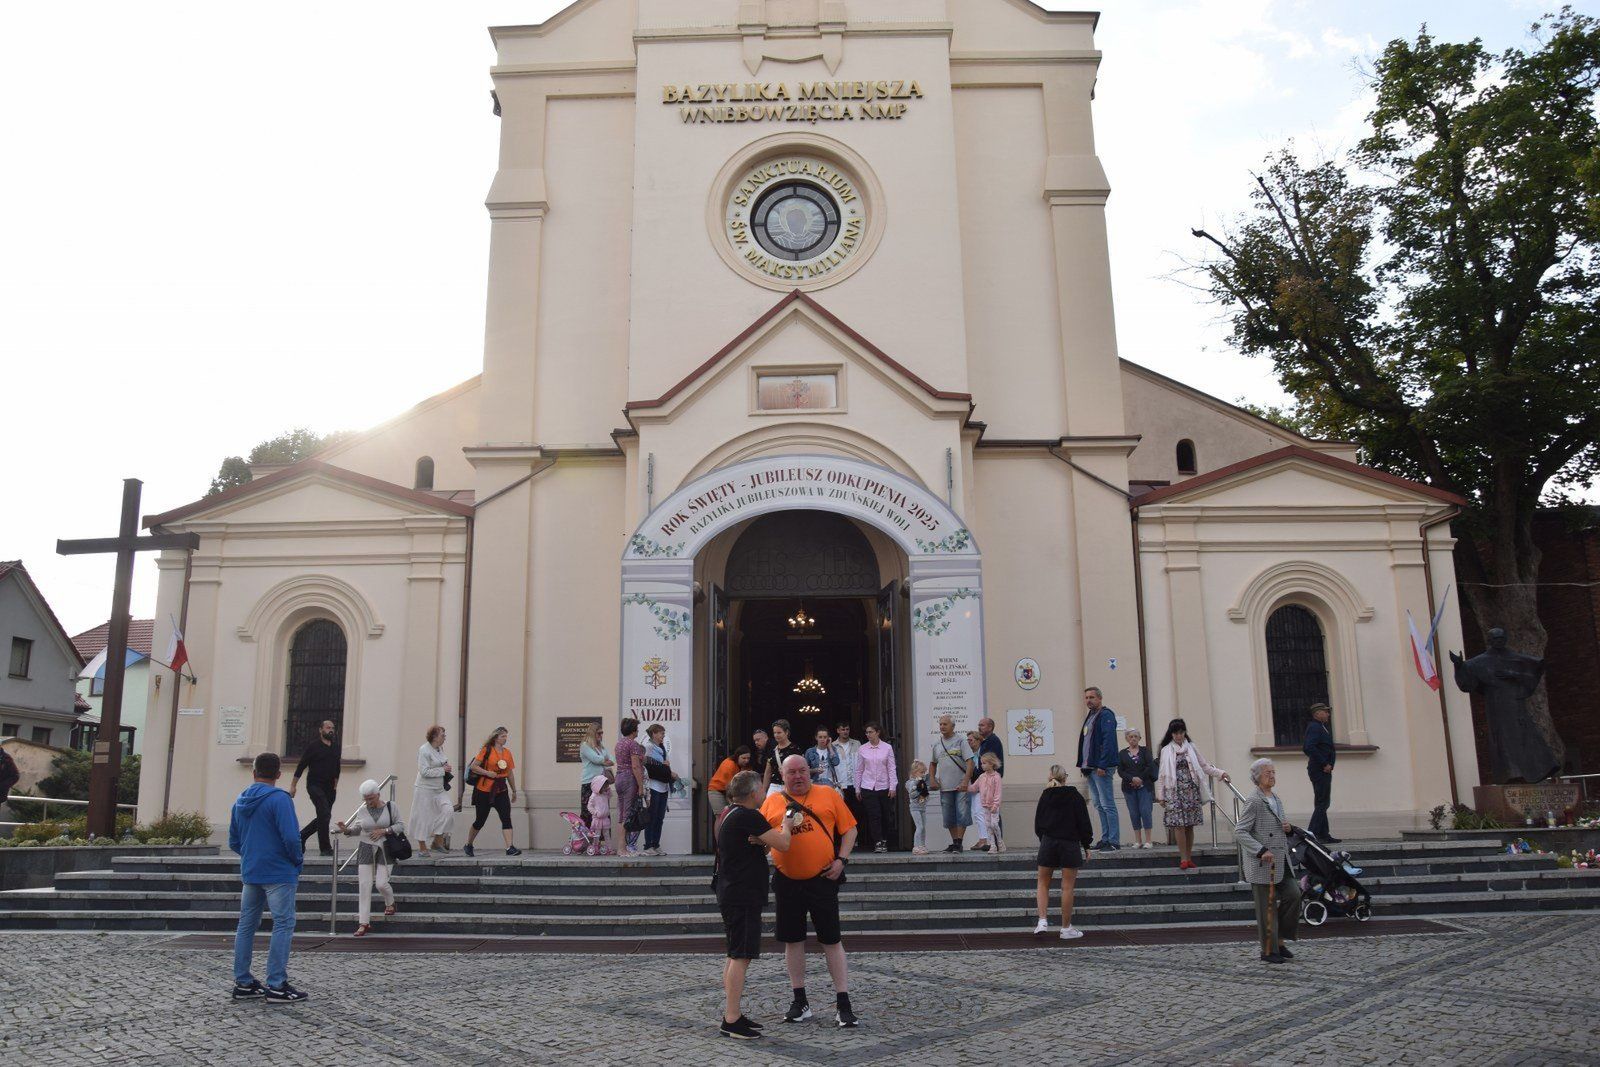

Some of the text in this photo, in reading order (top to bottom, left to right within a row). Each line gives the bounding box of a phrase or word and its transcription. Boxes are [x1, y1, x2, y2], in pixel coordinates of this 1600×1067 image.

[663, 80, 923, 104] BAZYLIKA MNIEJSZA
[680, 103, 909, 124] WNIEBOWZIĘCIA NMP
[734, 160, 856, 207] SANKTUARIUM
[745, 216, 862, 280] MAKSYMILIANA
[661, 510, 689, 536] ROK
[688, 481, 736, 515] ŚWIĘTY
[751, 468, 823, 489] JUBILEUSZ
[827, 470, 907, 508] ODKUPIENIA
[907, 502, 940, 531] 2025
[689, 487, 911, 535] BAZYLIKA JUBILEUSZOWA W ZDUŃSKIEJ WOLI
[630, 698, 681, 706] PIELGRZYMI
[630, 708, 681, 721] NADZIEI
